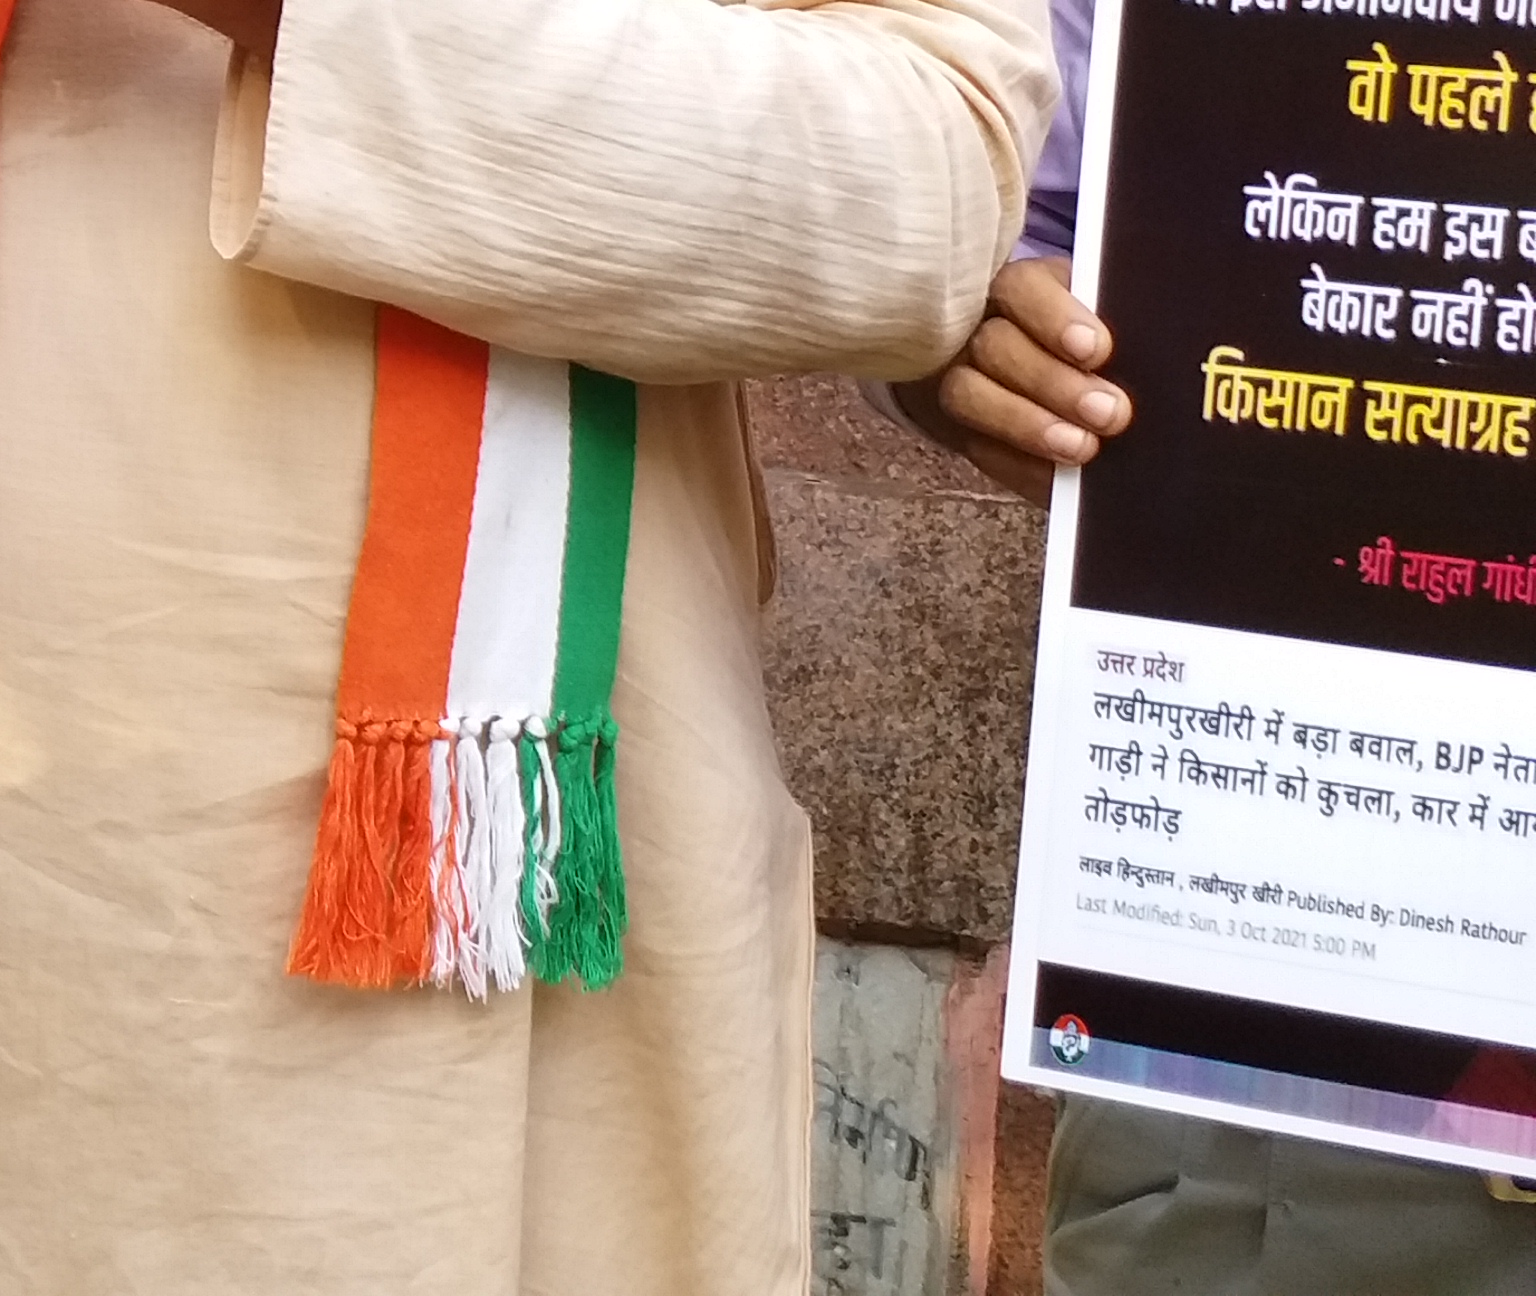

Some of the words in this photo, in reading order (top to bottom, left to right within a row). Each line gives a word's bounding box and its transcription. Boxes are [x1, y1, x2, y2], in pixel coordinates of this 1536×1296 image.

[1345, 41, 1398, 124] वो
[1406, 50, 1519, 134] पहले
[1242, 170, 1365, 247] लेकिन
[1371, 196, 1437, 254] हम
[1442, 203, 1510, 262] इस
[1300, 262, 1404, 341] बेकार
[1410, 277, 1494, 349] नहीं
[1200, 344, 1354, 438] किसान
[1362, 379, 1536, 459] सत्याग्रह
[1358, 536, 1395, 587] श्री
[1399, 550, 1477, 605] राहुल
[1096, 648, 1136, 676] उत्तर
[1141, 649, 1185, 684] प्रदेश
[1093, 688, 1256, 742] लखीमपुरखीरी
[1264, 710, 1286, 747] में
[1292, 720, 1340, 760] बड़ा
[1348, 727, 1425, 774] बवाल,
[1434, 740, 1485, 776] BJP
[1083, 787, 1183, 845] तोड़फोड़
[1088, 740, 1144, 778] गाड़ी
[1150, 744, 1171, 782] ने
[1177, 748, 1268, 798] किसानों
[1275, 766, 1309, 803] को
[1316, 777, 1403, 825] कुचला,
[1411, 793, 1461, 827] कार
[1468, 792, 1491, 832] में
[1076, 891, 1108, 916] Last
[1113, 897, 1183, 927] Modified:
[1187, 911, 1222, 937] Sun,
[1226, 918, 1237, 936] 3
[1240, 921, 1268, 943] Oct
[1272, 926, 1308, 949] 2021
[1312, 931, 1347, 957] 5:00
[1351, 938, 1378, 962] PM
[1079, 855, 1113, 878] लाइव
[1188, 872, 1247, 904] लखीमपुर
[1251, 881, 1284, 906] खीरी
[1287, 889, 1366, 921] Published
[1369, 903, 1395, 929] By:
[1399, 907, 1456, 934] Dinesh
[1459, 917, 1528, 947] Rathour
